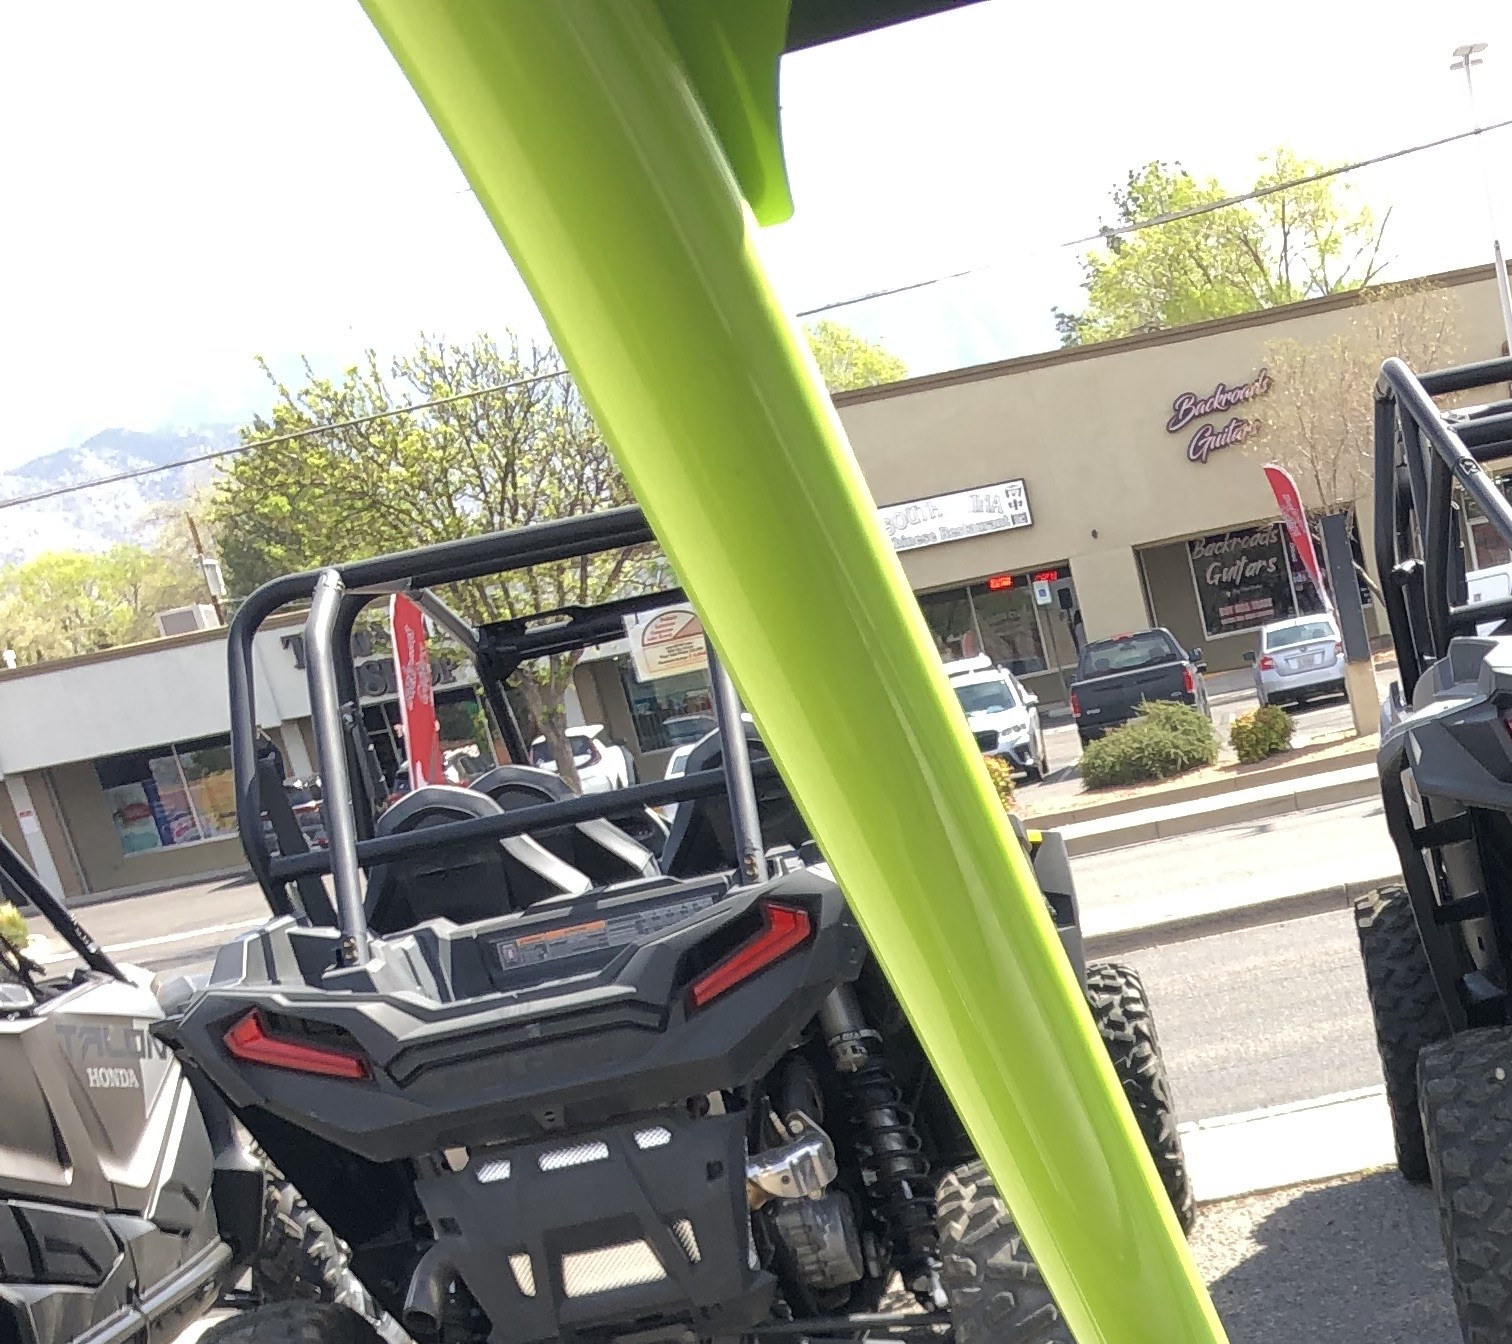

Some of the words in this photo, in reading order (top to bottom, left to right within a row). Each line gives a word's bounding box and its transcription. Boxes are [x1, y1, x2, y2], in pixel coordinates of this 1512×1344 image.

[1167, 368, 1273, 433] Backroads
[1187, 417, 1262, 463] Guitars
[891, 530, 938, 550] hinese
[1193, 524, 1278, 559] Backroads
[1206, 555, 1278, 586] Guitars
[86, 1067, 140, 1088] HONDA
